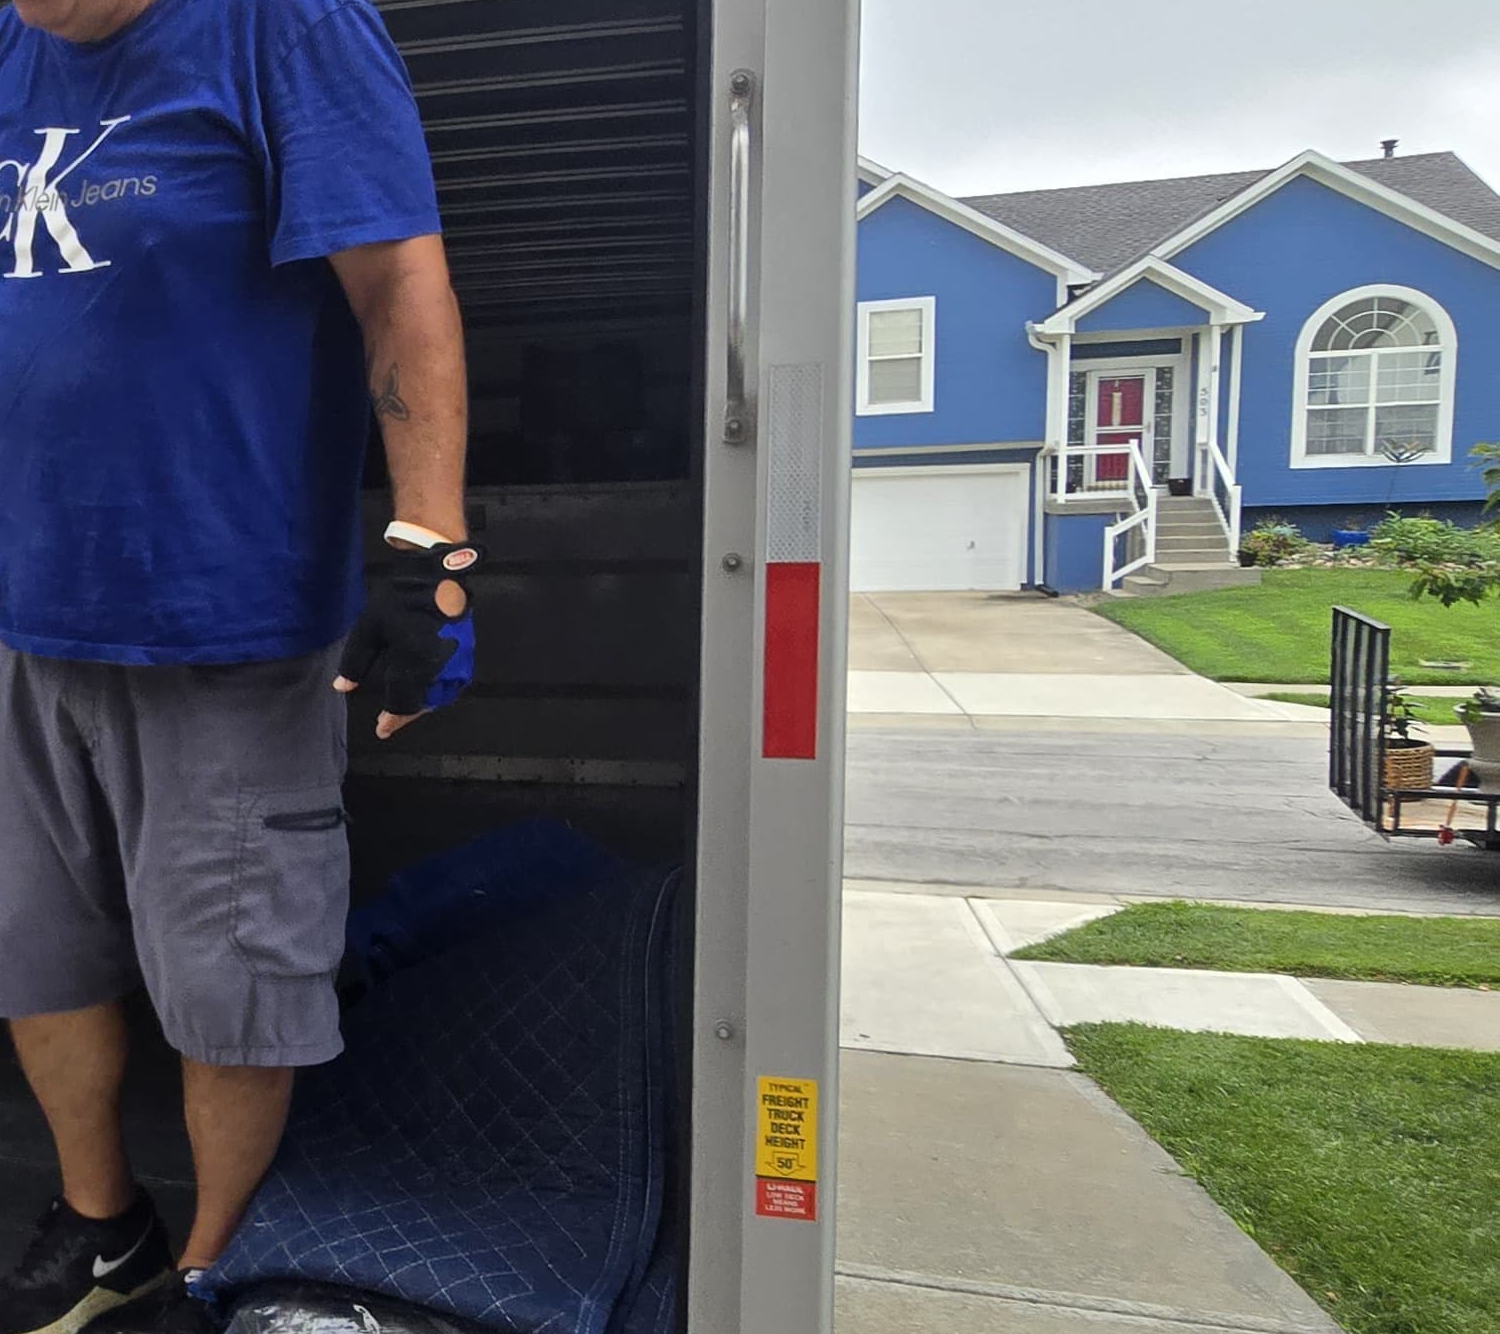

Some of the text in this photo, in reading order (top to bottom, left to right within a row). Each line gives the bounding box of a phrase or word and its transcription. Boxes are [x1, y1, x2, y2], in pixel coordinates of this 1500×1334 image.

[71, 174, 158, 208] Jeans
[762, 1094, 809, 1109] FREIGHT
[767, 1108, 804, 1122] TRUCK
[770, 1122, 801, 1135] DECK
[765, 1135, 805, 1150] HEIGHT
